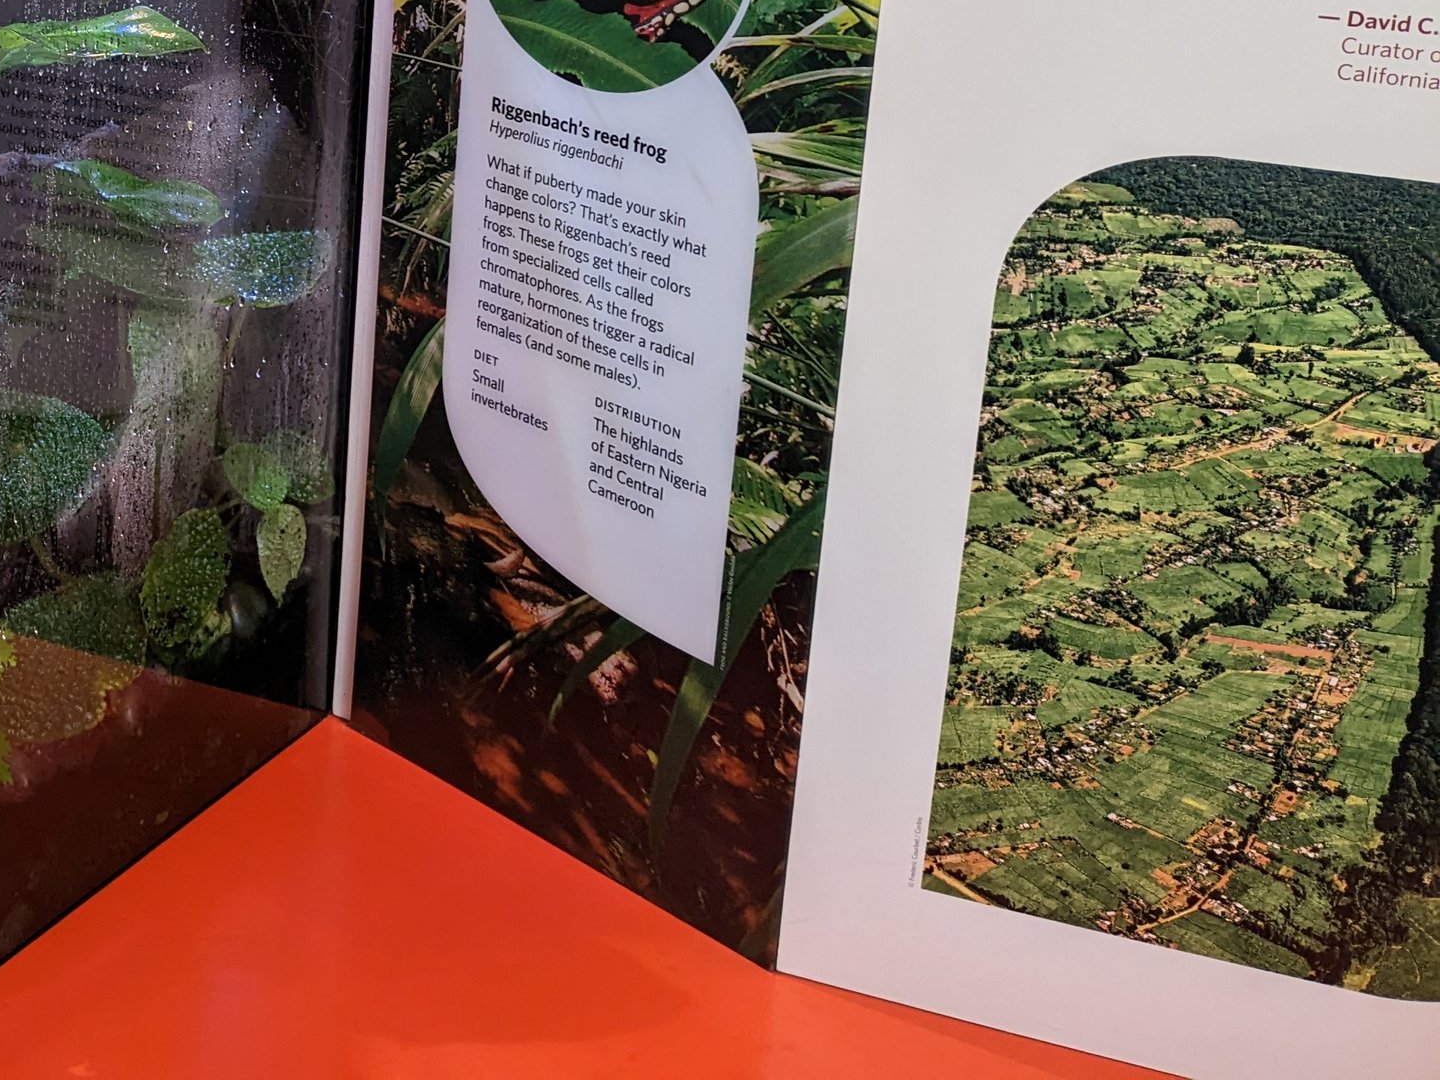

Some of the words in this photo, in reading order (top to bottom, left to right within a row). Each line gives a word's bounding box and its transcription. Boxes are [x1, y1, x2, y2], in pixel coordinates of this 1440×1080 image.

[1342, 37, 1424, 61] Curator
[1347, 10, 1411, 32] David
[1418, 18, 1438, 35] C.
[1338, 64, 1440, 90] California
[490, 119, 550, 148] Hyperolius
[553, 139, 624, 170] riggenbachi
[492, 96, 590, 138] Riggenbach’s
[594, 129, 630, 150] reed
[633, 136, 667, 164] frog
[486, 176, 528, 201] change
[532, 193, 576, 214] colors?
[580, 204, 618, 229] That’s
[622, 222, 669, 247] exactly
[673, 237, 706, 257] what
[487, 154, 520, 177] What
[524, 166, 532, 179] if
[534, 173, 583, 198] puberty
[586, 189, 622, 208] made
[626, 201, 656, 218] your
[659, 209, 686, 228] skin
[483, 215, 515, 238] frogs.
[519, 227, 555, 251] These
[558, 240, 589, 263] frogs
[592, 256, 613, 271] get
[617, 261, 647, 281] their
[651, 276, 691, 297] colors
[485, 195, 535, 223] happens
[538, 214, 551, 228] to
[555, 218, 637, 257] Riggenbach’s
[641, 250, 671, 268] reed
[481, 257, 582, 303] chromatophores.
[586, 294, 603, 310] As
[607, 301, 627, 319] the
[631, 309, 663, 333] frogs
[482, 236, 509, 256] from
[512, 250, 579, 281] specialized
[583, 275, 611, 292] cells
[615, 286, 653, 307] called
[478, 299, 562, 339] reorganization
[566, 331, 579, 344] of
[582, 335, 616, 359] these
[620, 353, 649, 371] cells
[653, 360, 664, 377] in
[479, 279, 523, 305] mature,
[527, 293, 589, 327] hormones
[593, 318, 635, 343] trigger
[638, 337, 646, 348] a
[650, 341, 694, 366] radical
[474, 349, 499, 366] DIET
[477, 315, 522, 344] females
[525, 335, 553, 356] (and
[556, 350, 590, 370] some
[594, 364, 640, 390] males).
[472, 369, 504, 392] Small
[471, 388, 548, 431] invertebrates
[595, 397, 681, 439] DISTRIBUTION
[593, 417, 617, 438] The
[621, 428, 683, 465] highlands
[589, 462, 613, 479] and
[617, 470, 663, 500] Central
[591, 441, 604, 454] of
[608, 444, 655, 475] Eastern
[659, 466, 706, 497] Nigeria
[588, 479, 654, 518] Cameroon
